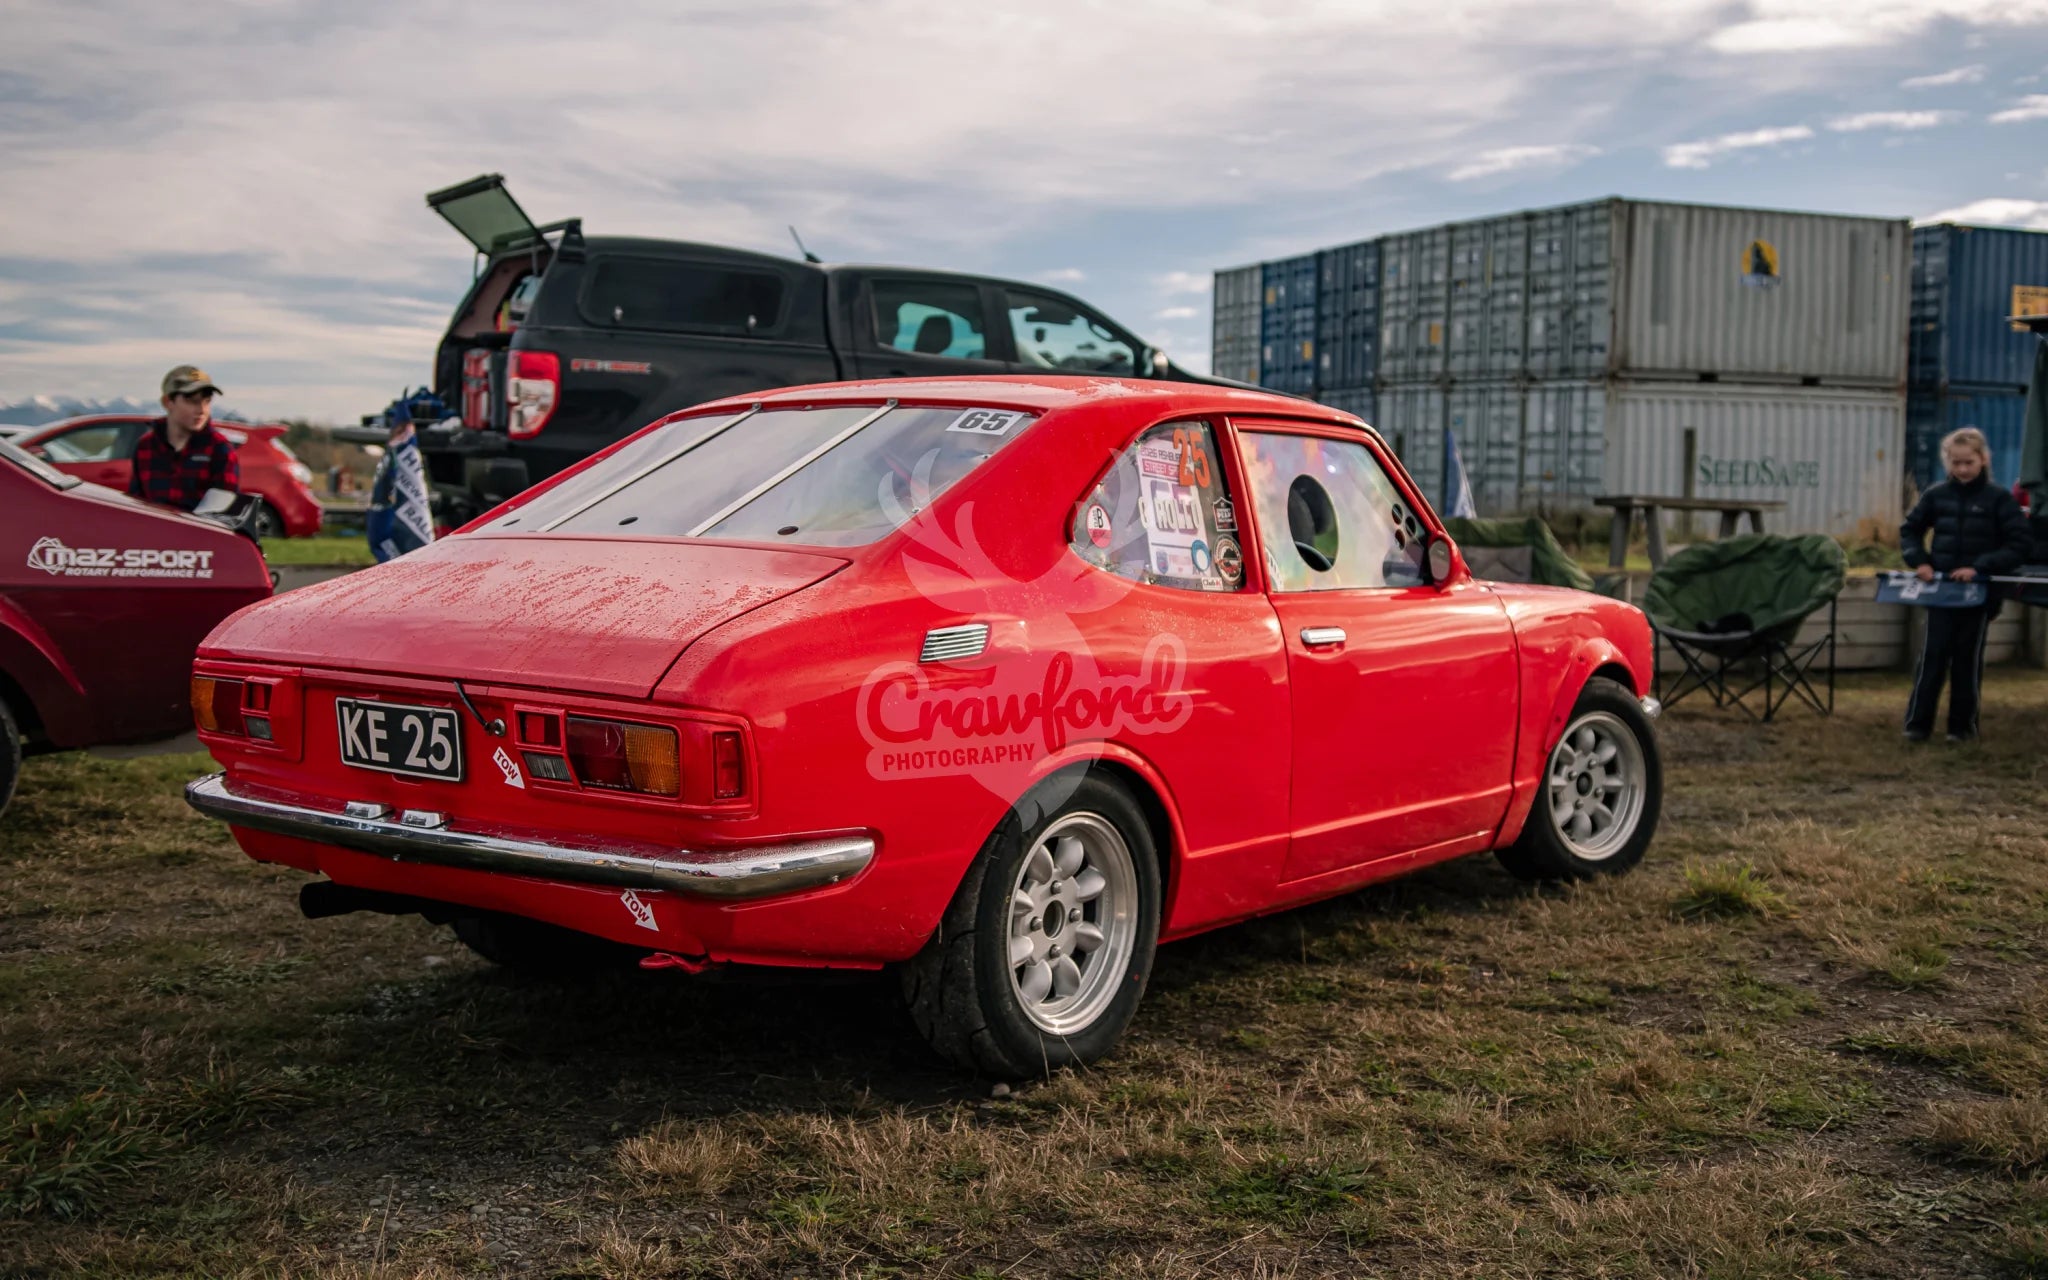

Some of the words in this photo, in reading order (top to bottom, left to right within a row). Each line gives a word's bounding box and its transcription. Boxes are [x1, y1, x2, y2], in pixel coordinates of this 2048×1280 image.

[958, 411, 1014, 431] 65
[1173, 428, 1211, 489] 25
[65, 568, 109, 577] ROTARY
[111, 568, 195, 578] PERFORMANCE
[196, 569, 213, 579] NZ
[342, 706, 389, 763] KE
[402, 714, 452, 771] 25
[496, 750, 519, 780] TOW
[625, 891, 650, 922] TOW
